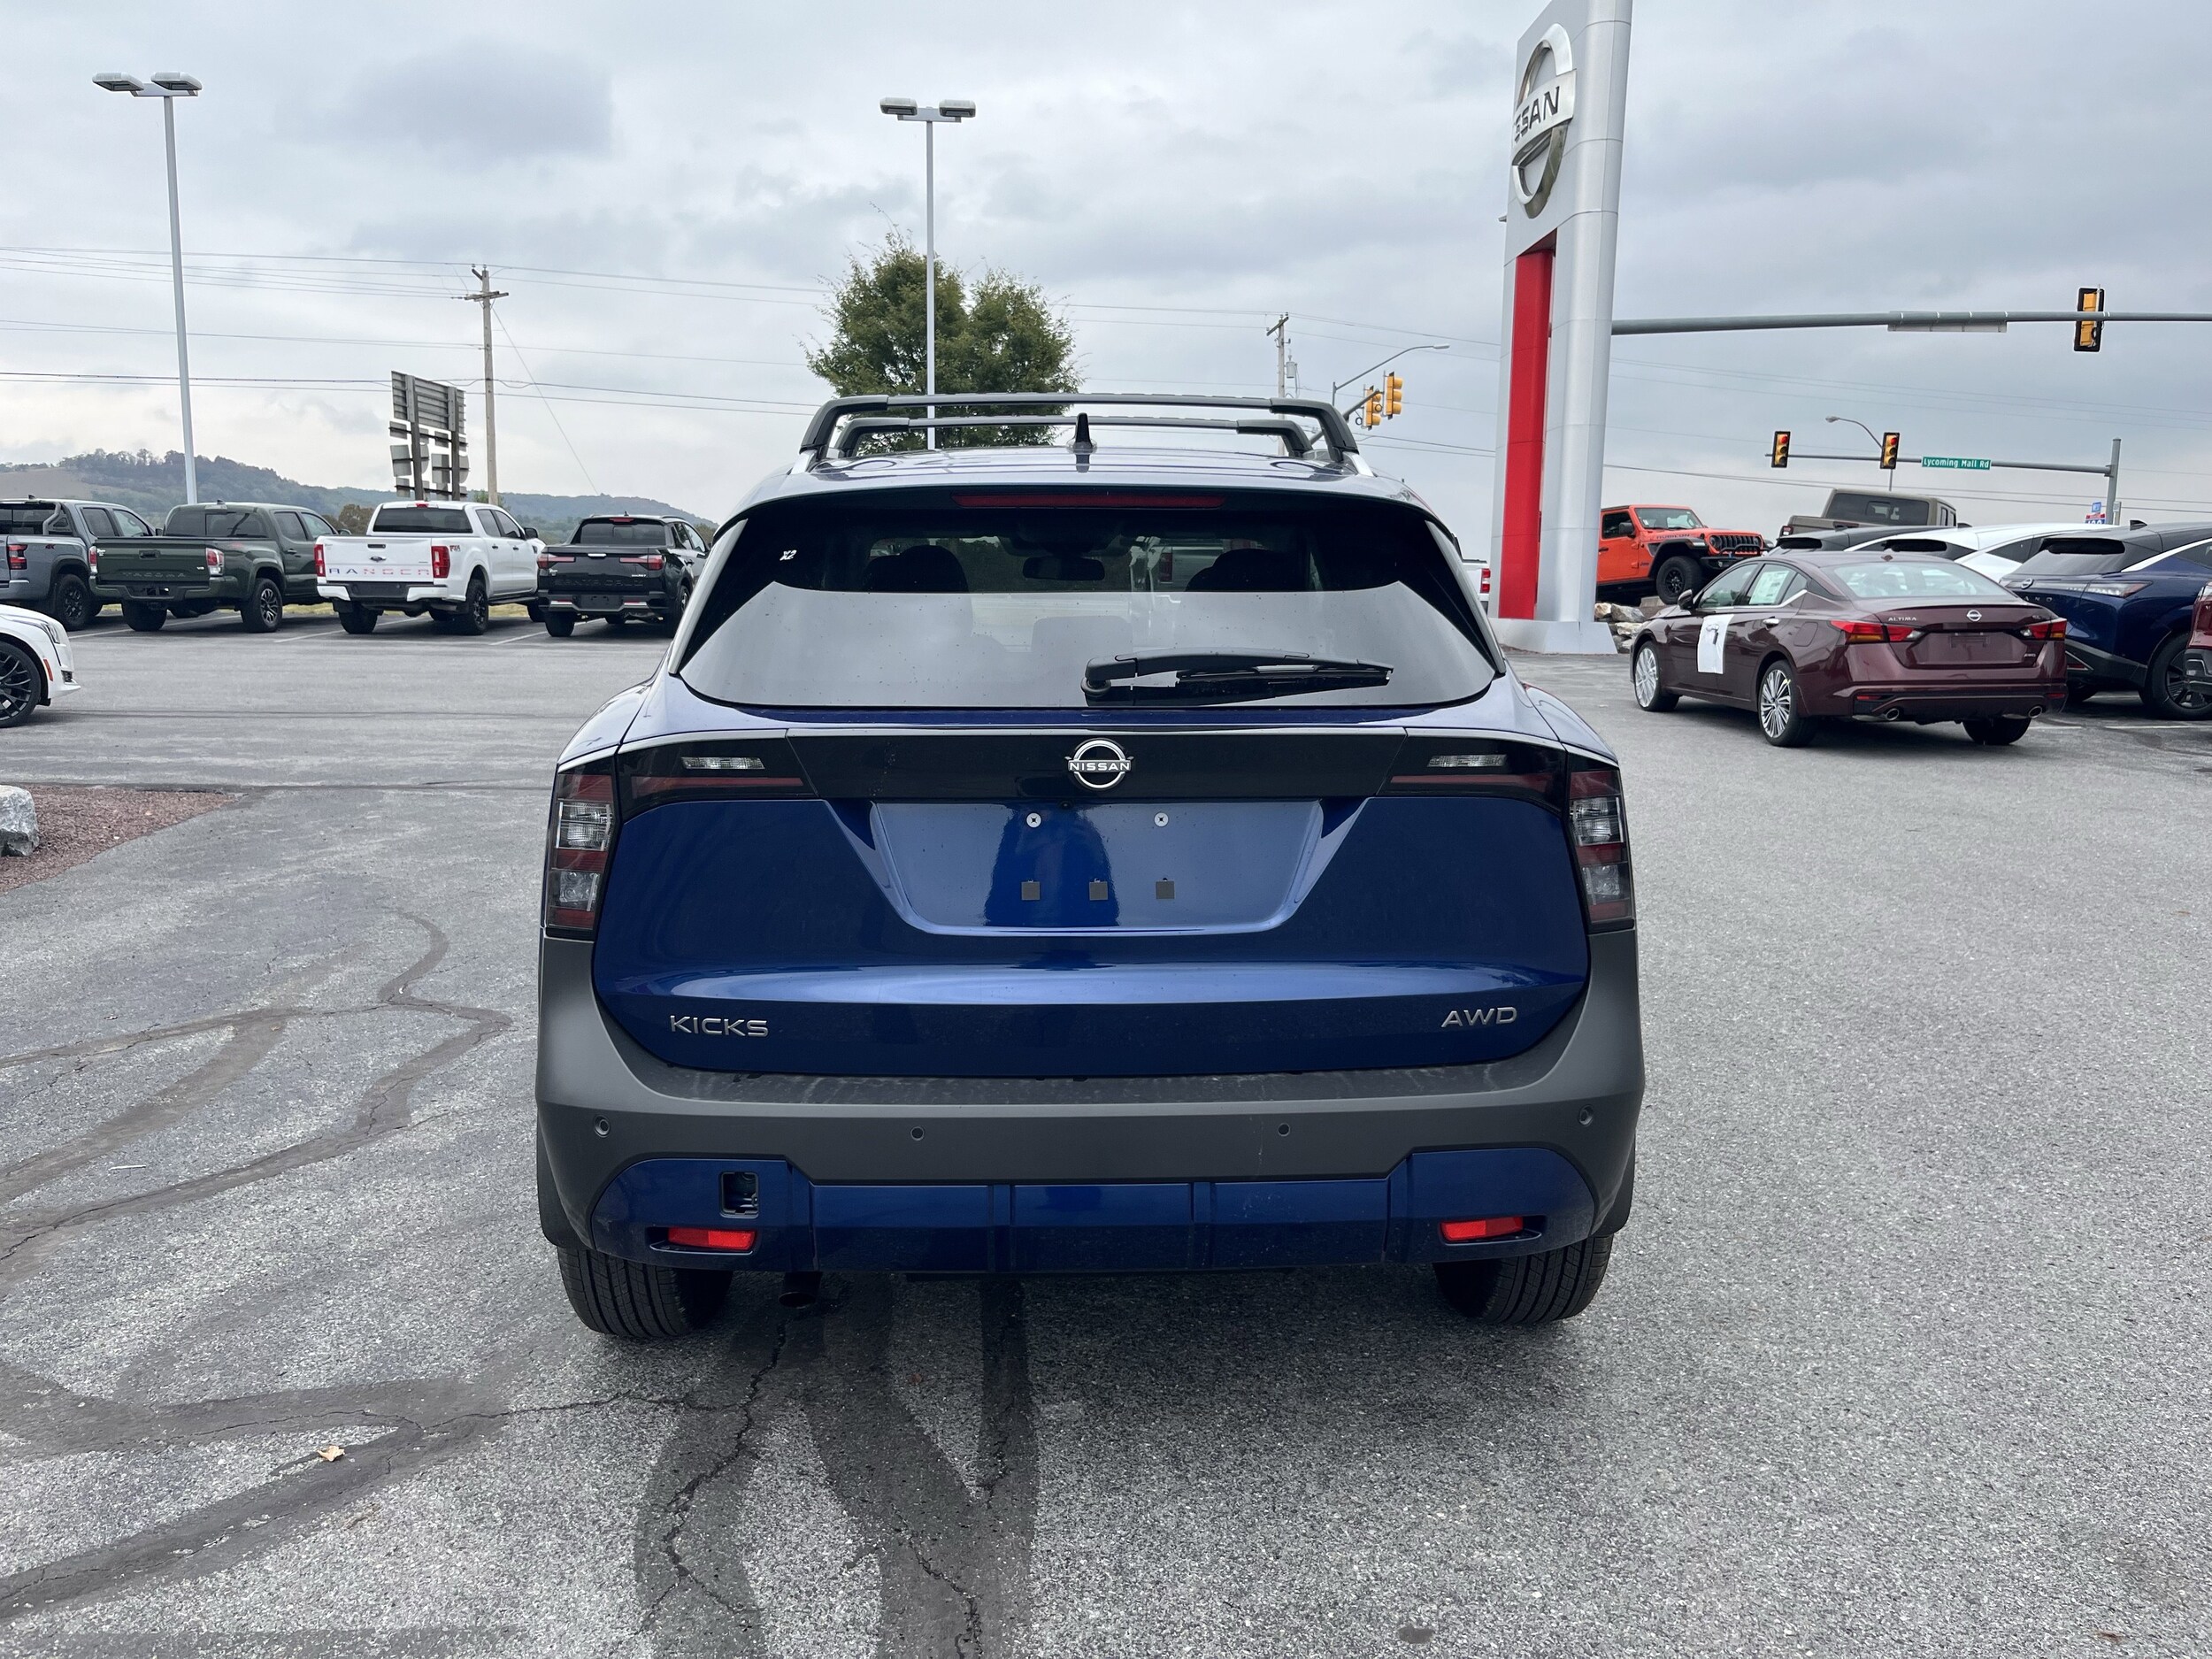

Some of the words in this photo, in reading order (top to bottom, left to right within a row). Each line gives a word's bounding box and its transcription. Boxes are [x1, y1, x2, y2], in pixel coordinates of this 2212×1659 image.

[1924, 457, 1958, 468] Lycoming
[1961, 459, 1978, 468] Mall
[1069, 762, 1130, 772] NISSAN
[1440, 1007, 1518, 1028] AWD
[670, 1015, 769, 1037] KICKS
